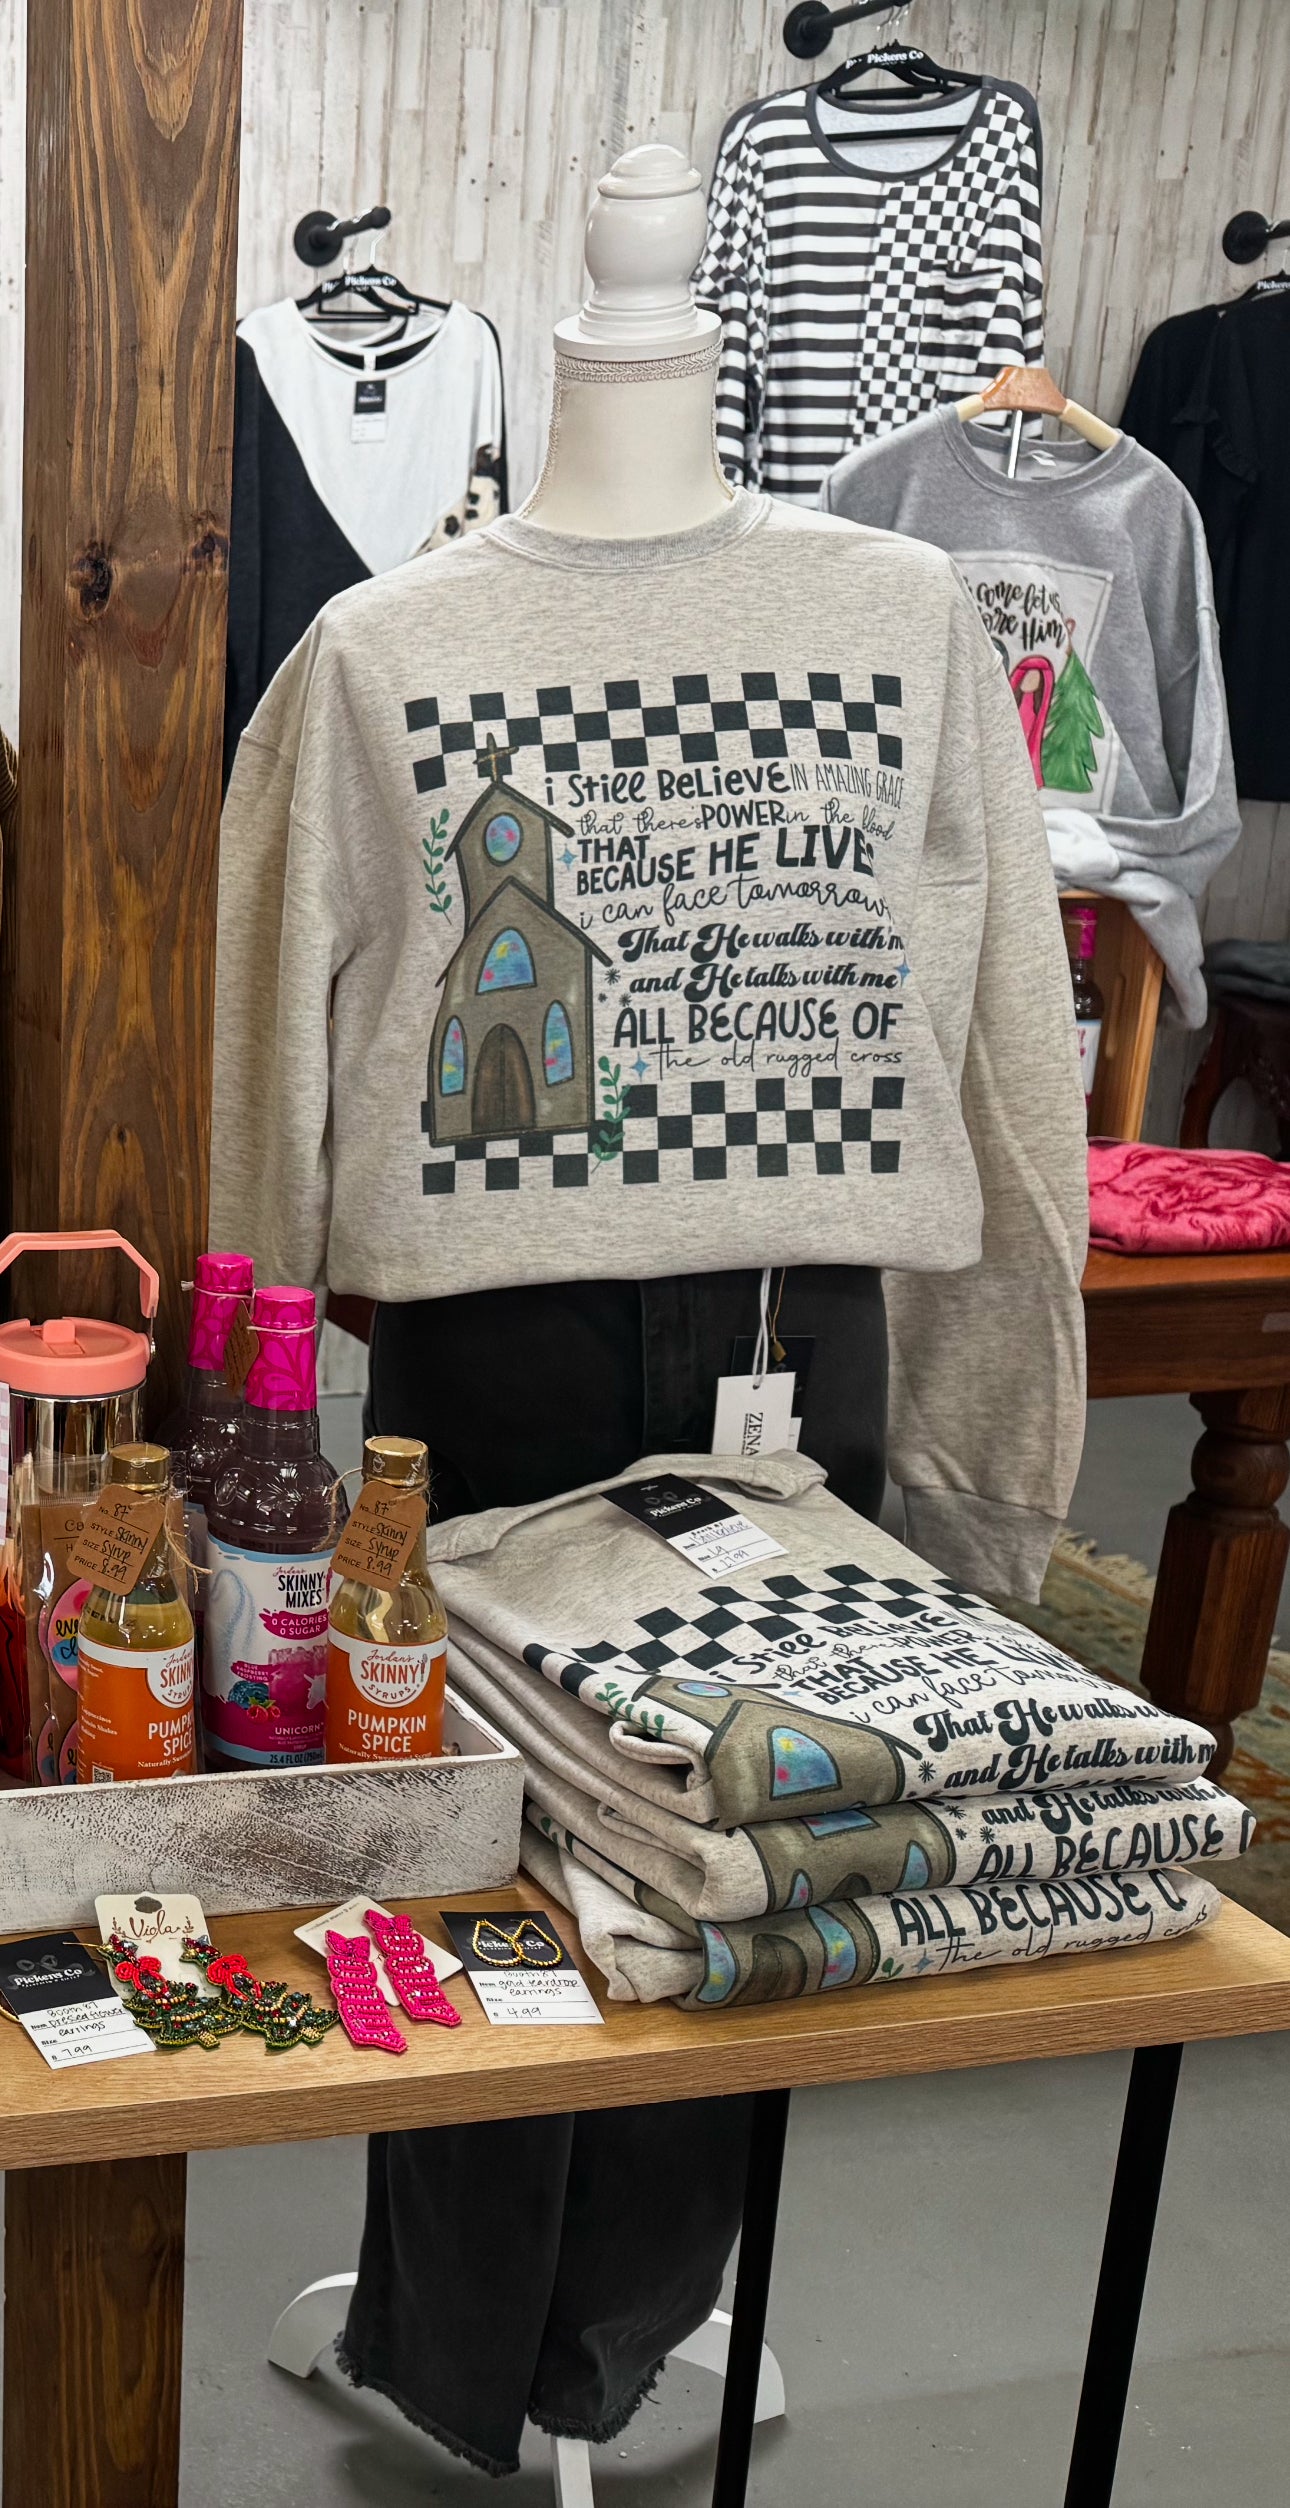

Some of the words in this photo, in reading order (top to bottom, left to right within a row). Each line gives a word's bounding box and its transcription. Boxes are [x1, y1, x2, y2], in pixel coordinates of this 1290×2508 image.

[908, 50, 924, 59] Co
[1020, 617, 1066, 651] Him
[544, 777, 554, 806] i
[790, 763, 809, 791] IN
[815, 763, 872, 798] AMAZING
[576, 809, 624, 837] that
[701, 800, 786, 830] POWER
[785, 809, 809, 824] in
[820, 797, 855, 824] the
[862, 805, 896, 841] blood
[577, 835, 650, 863] THAT
[577, 847, 696, 896] BECAUSE
[709, 832, 760, 876] HE
[602, 903, 654, 923] can
[663, 883, 727, 927] face
[618, 925, 692, 962] That
[690, 923, 750, 963] He
[752, 923, 823, 948] walks
[826, 926, 887, 949] with
[630, 968, 686, 993] and
[684, 963, 743, 1002] He
[745, 963, 801, 987] talks
[802, 962, 859, 986] with
[859, 972, 898, 989] me
[613, 1007, 675, 1048] ALL
[688, 997, 839, 1044] BECAUSE
[852, 1002, 903, 1040] OF
[648, 1042, 711, 1080] the
[721, 1039, 755, 1072] old
[766, 1036, 839, 1078] rugged
[851, 1051, 903, 1063] cross
[374, 1500, 389, 1515] 87
[90, 1523, 113, 1537] STYLE
[352, 1521, 376, 1533] STYLE
[83, 1539, 99, 1550] SIZE
[345, 1538, 362, 1549] SIZE
[75, 1555, 98, 1570] PRICE
[102, 1558, 127, 1580] 8.99
[337, 1555, 362, 1568] PRICE
[367, 1556, 392, 1576] 8.99
[278, 1571, 324, 1591] SKINNY
[286, 1589, 322, 1608] MIXES
[281, 1614, 327, 1626] CALORIES
[289, 1625, 320, 1636] SUGAR
[893, 1629, 983, 1650] POWER
[160, 1660, 193, 1688] SKINN
[361, 1660, 420, 1684] SKINNY
[789, 1656, 875, 1692] THAT
[813, 1655, 943, 1706] BECAUSE
[929, 1647, 1000, 1671] HE
[368, 1684, 411, 1699] SYRUPS
[872, 1692, 929, 1715] can
[921, 1673, 997, 1710] face
[148, 1711, 192, 1740] PUMPK
[275, 1724, 320, 1735] UNICORN
[348, 1708, 427, 1734] PUMPKIN
[913, 1709, 994, 1752] That
[993, 1698, 1058, 1747] He
[1058, 1698, 1137, 1721] walks
[163, 1727, 192, 1757] SPICE
[339, 1743, 371, 1759] Naturally
[362, 1732, 412, 1753] SPICE
[138, 1757, 171, 1768] Naturally
[944, 1753, 1002, 1789] and
[998, 1743, 1061, 1790] He
[1063, 1738, 1132, 1770] talks
[1134, 1734, 1197, 1765] with
[981, 1799, 1035, 1826] and
[1095, 1785, 1160, 1810] talks
[974, 1843, 1035, 1884] ALL
[1051, 1814, 1224, 1879] BECAUSE
[890, 1893, 966, 1946] ALL
[961, 1874, 1152, 1935] BECAUSE
[129, 1910, 181, 1943] Viola
[936, 1936, 1002, 1971] the
[1011, 1924, 1053, 1957] old
[1063, 1911, 1154, 1950] rugged
[14, 1971, 63, 1985] Pickens
[64, 1968, 82, 1976] Co
